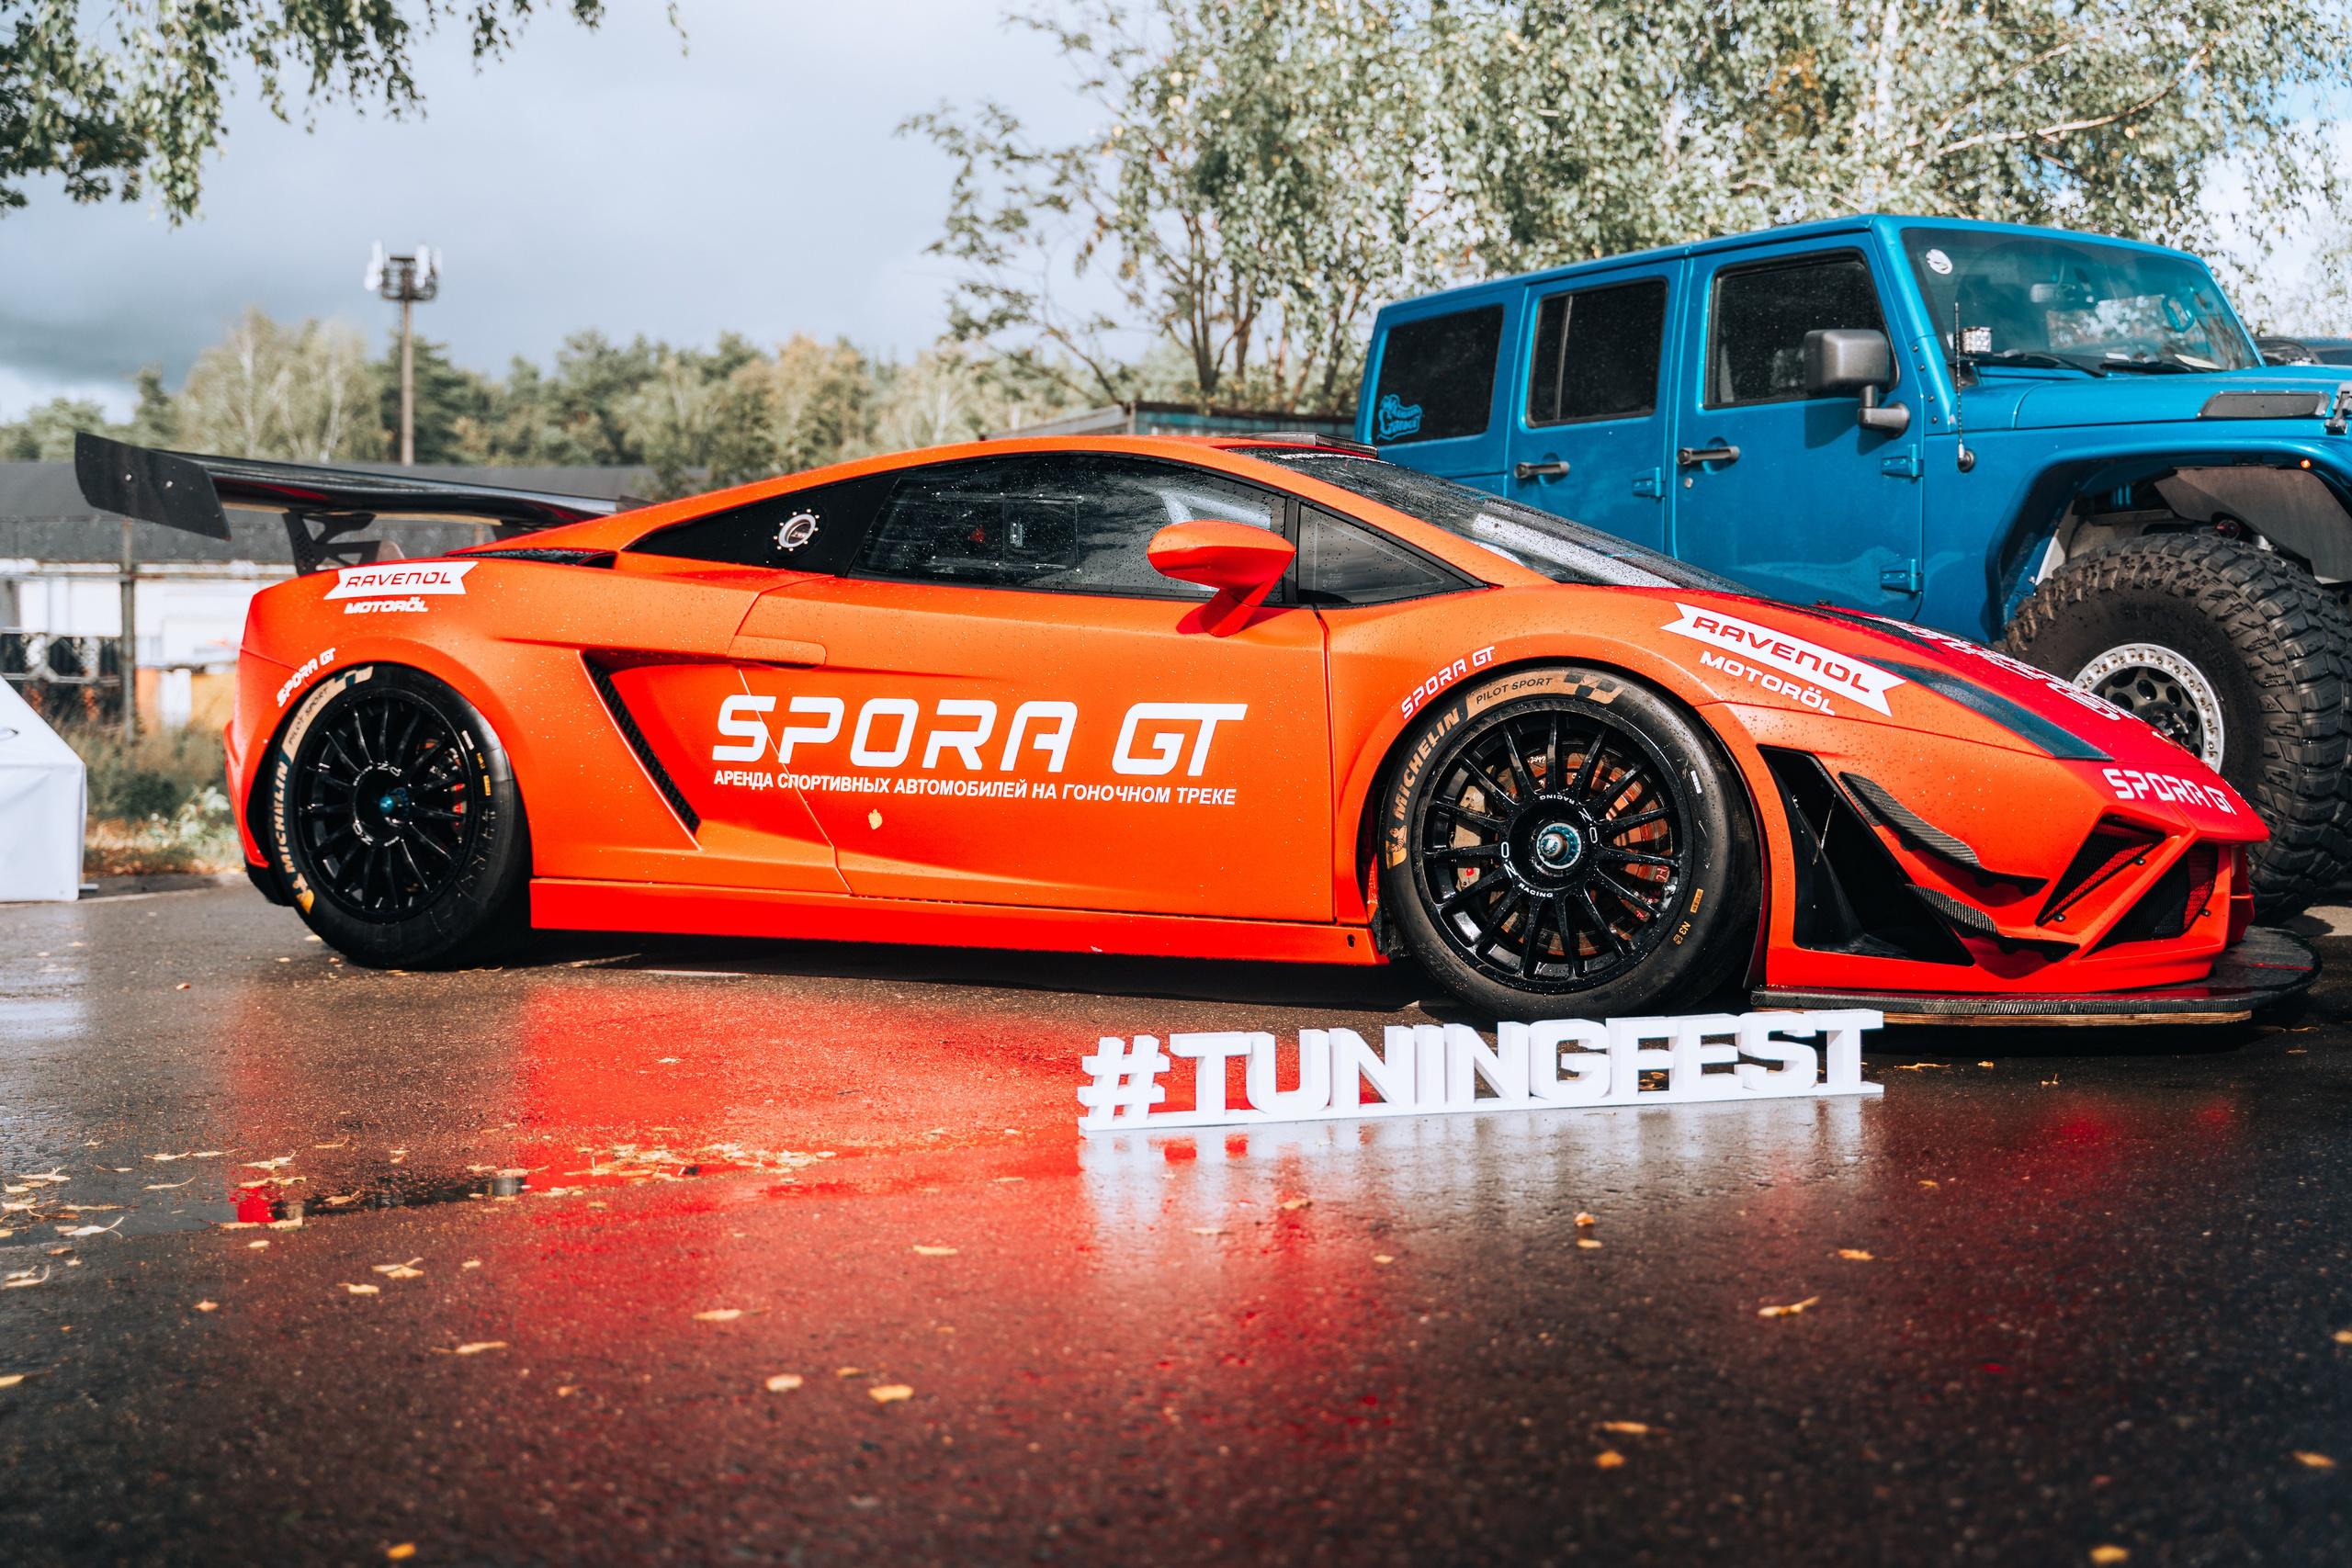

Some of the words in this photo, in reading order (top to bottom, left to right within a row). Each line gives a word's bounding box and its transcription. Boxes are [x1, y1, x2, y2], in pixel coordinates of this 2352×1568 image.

[344, 596, 429, 615] MOTORÖL
[345, 571, 451, 588] RAVENOL
[277, 658, 319, 708] SPORA
[320, 648, 336, 666] GT
[1401, 659, 1467, 720] SPORA
[1472, 646, 1496, 667] GT
[1692, 616, 1871, 694] RAVENOL
[1700, 650, 1836, 716] MOTORÖL
[288, 716, 305, 746] PILOT
[305, 686, 329, 716] SPORT
[1476, 684, 1510, 705] PILOT
[1511, 677, 1553, 691] SPORT
[712, 694, 1078, 772] SPORA
[1111, 702, 1249, 776] GT
[1393, 707, 1460, 821] MICHELIN
[714, 770, 774, 790] АРЕНДА
[777, 773, 891, 794] СПОРТИВНЫХ
[893, 778, 1027, 798] АВТОМОБИЛЕЙ
[1031, 783, 1057, 800] НА
[1062, 784, 1171, 804] ГОНОЧНОМ
[1176, 787, 1238, 806] ТРЕКЕ
[1539, 794, 1575, 805] RACING
[2102, 768, 2212, 808] SPORA
[2202, 784, 2238, 816] GT
[1518, 882, 1554, 898] RACING
[1078, 1009, 1884, 1131] #TUNINGFEST
